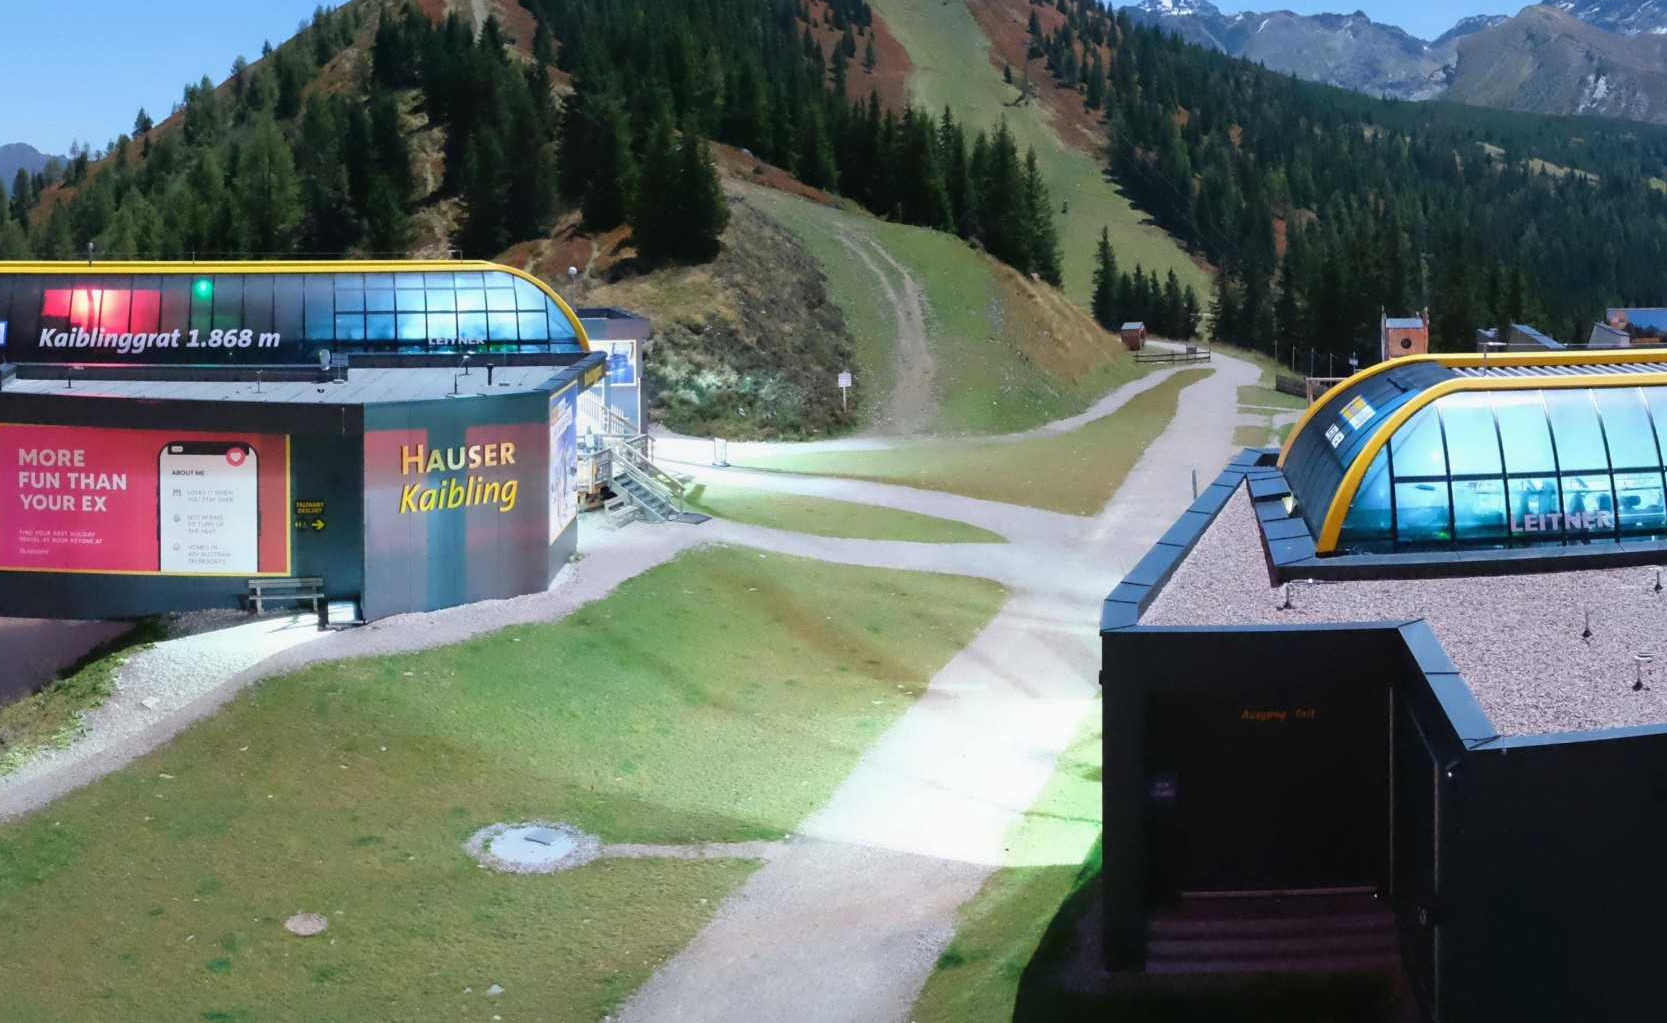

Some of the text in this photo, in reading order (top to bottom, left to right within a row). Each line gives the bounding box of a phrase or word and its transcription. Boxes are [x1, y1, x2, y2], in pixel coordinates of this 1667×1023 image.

[39, 327, 280, 354] Kaiblinggrat 1.868 m
[428, 336, 485, 345] LEITNER
[18, 448, 85, 467] MORE
[400, 442, 516, 475] HAUSER
[18, 471, 127, 491] FUN THAN
[20, 494, 107, 512] YOUR EX
[399, 475, 518, 513] Kaibling
[1510, 510, 1615, 532] LEITNER
[1241, 708, 1316, 721] Ausgang Exit
